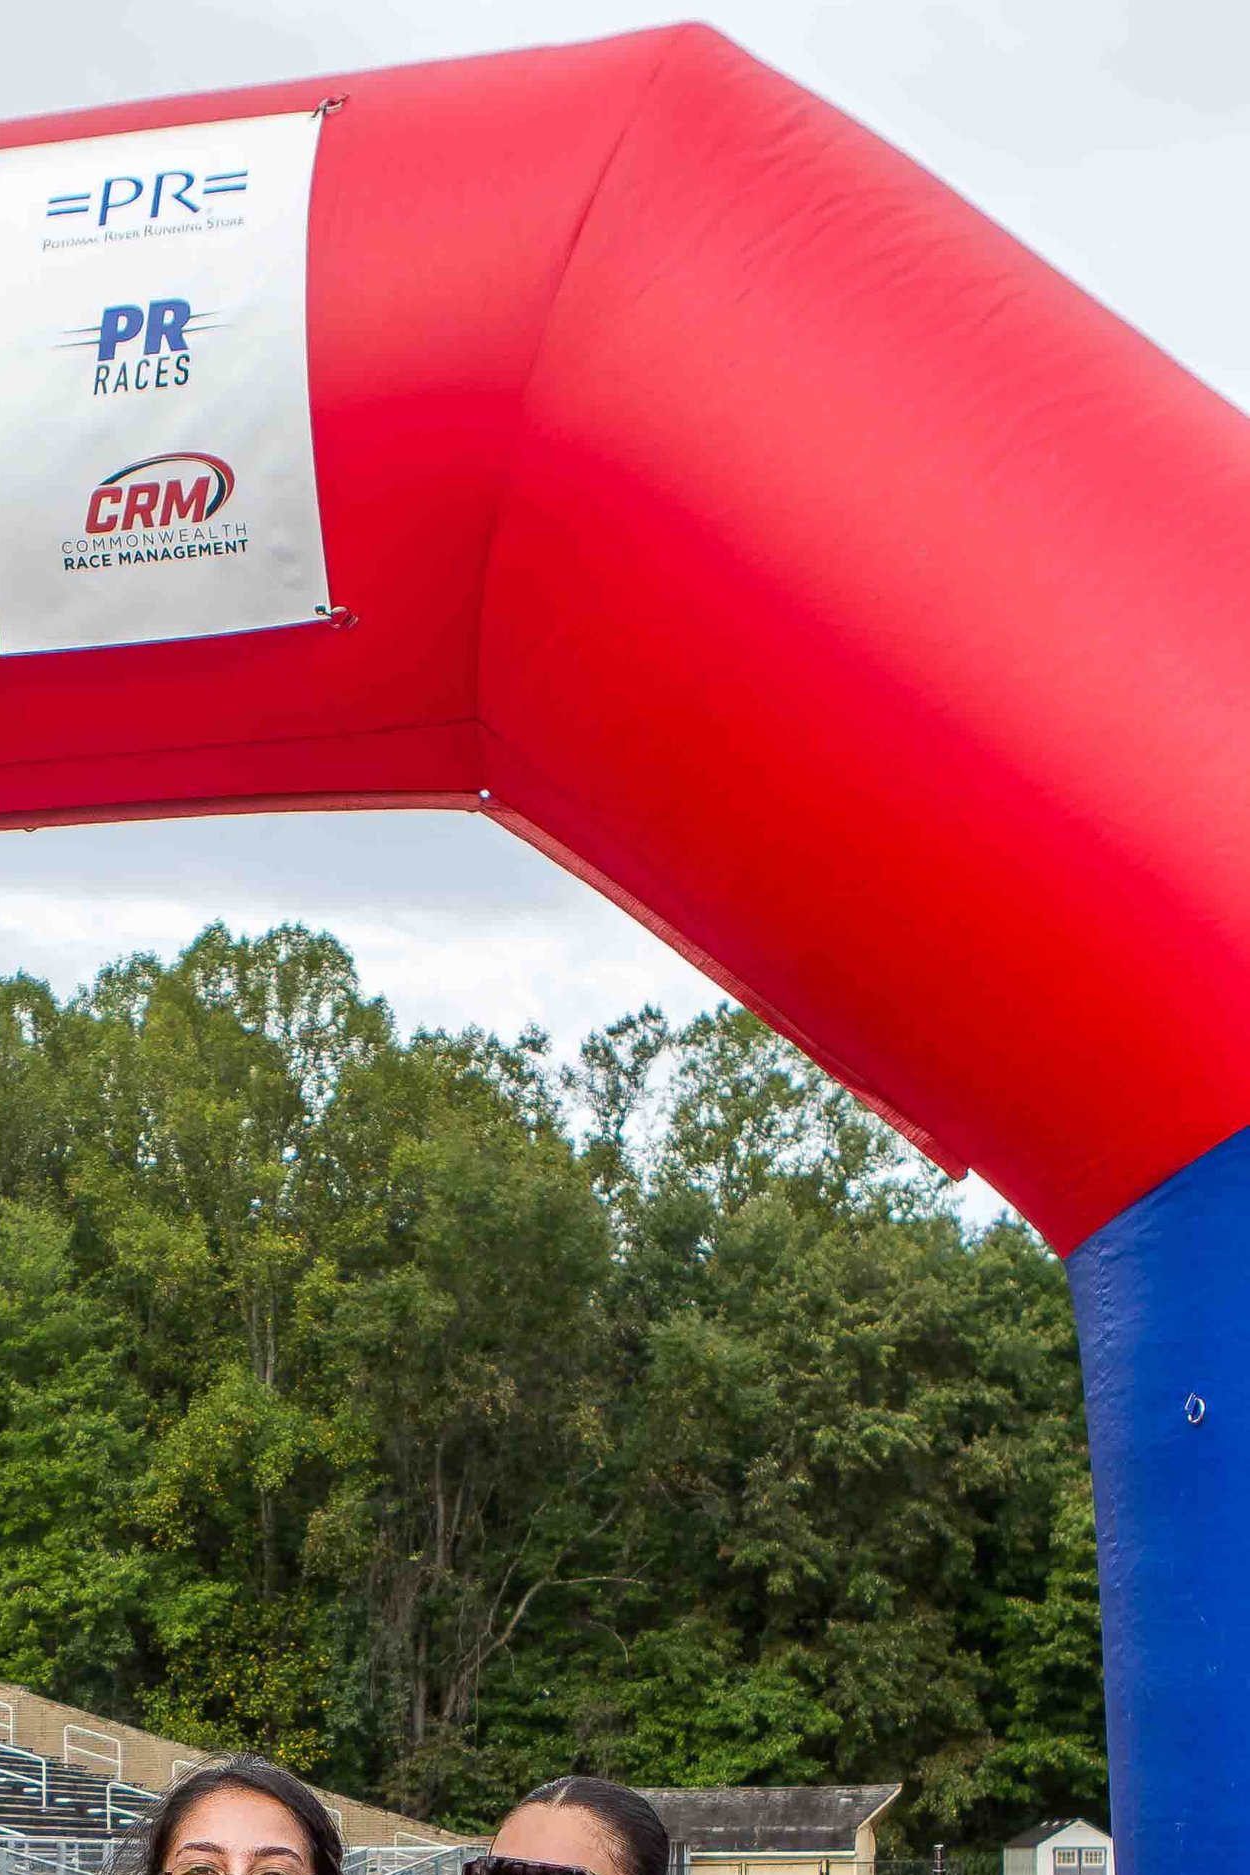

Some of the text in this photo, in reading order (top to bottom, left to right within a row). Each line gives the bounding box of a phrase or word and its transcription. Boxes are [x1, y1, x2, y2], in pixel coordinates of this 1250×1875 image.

[104, 229, 140, 243] RIVER
[143, 221, 202, 237] RUNNING
[97, 297, 191, 362] PR
[93, 353, 191, 396] RACES
[85, 476, 211, 534] CRM
[61, 523, 248, 555] COMMONWEALTH
[64, 539, 249, 571] RACE MANAGEMENT
